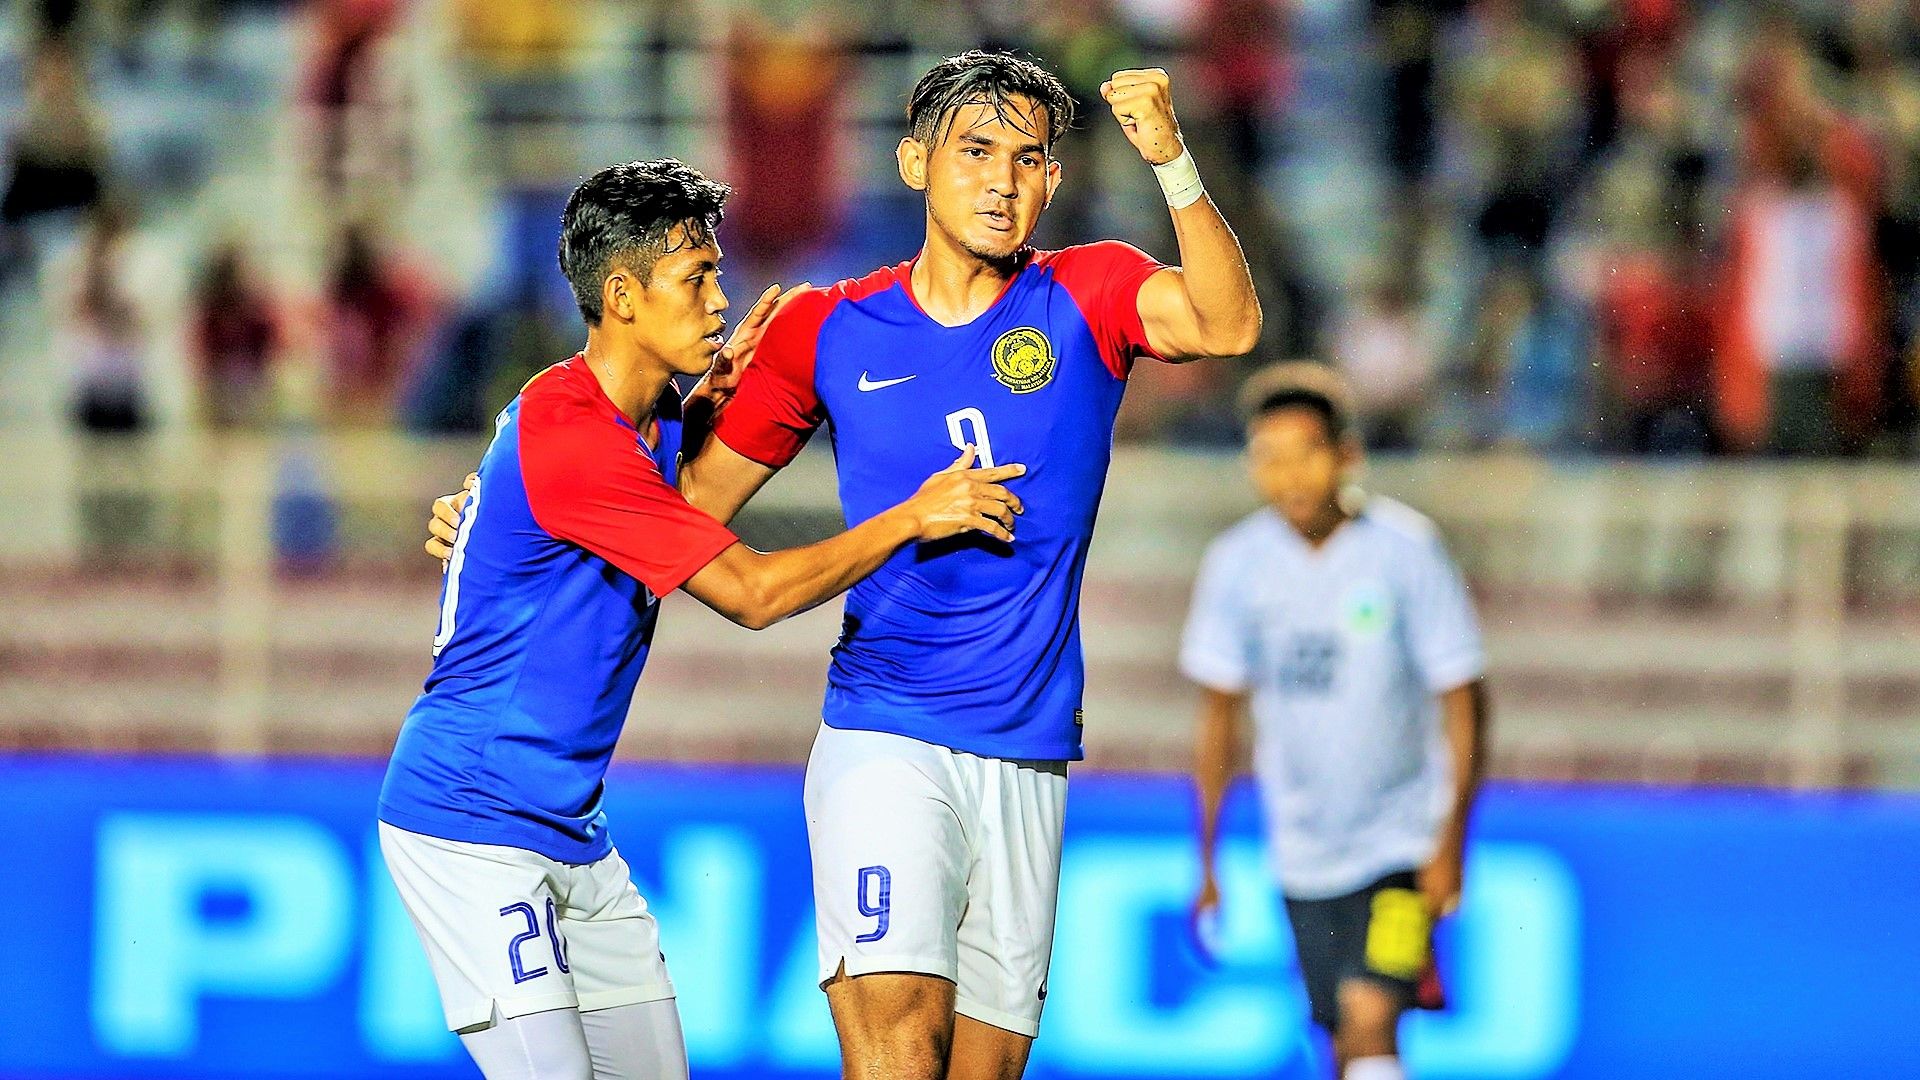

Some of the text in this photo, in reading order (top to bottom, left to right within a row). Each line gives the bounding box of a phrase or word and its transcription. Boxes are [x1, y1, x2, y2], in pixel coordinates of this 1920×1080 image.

[944, 406, 996, 469] 9
[93, 810, 1592, 1078] PINCO
[499, 896, 570, 985] 20
[856, 865, 892, 944] 9
